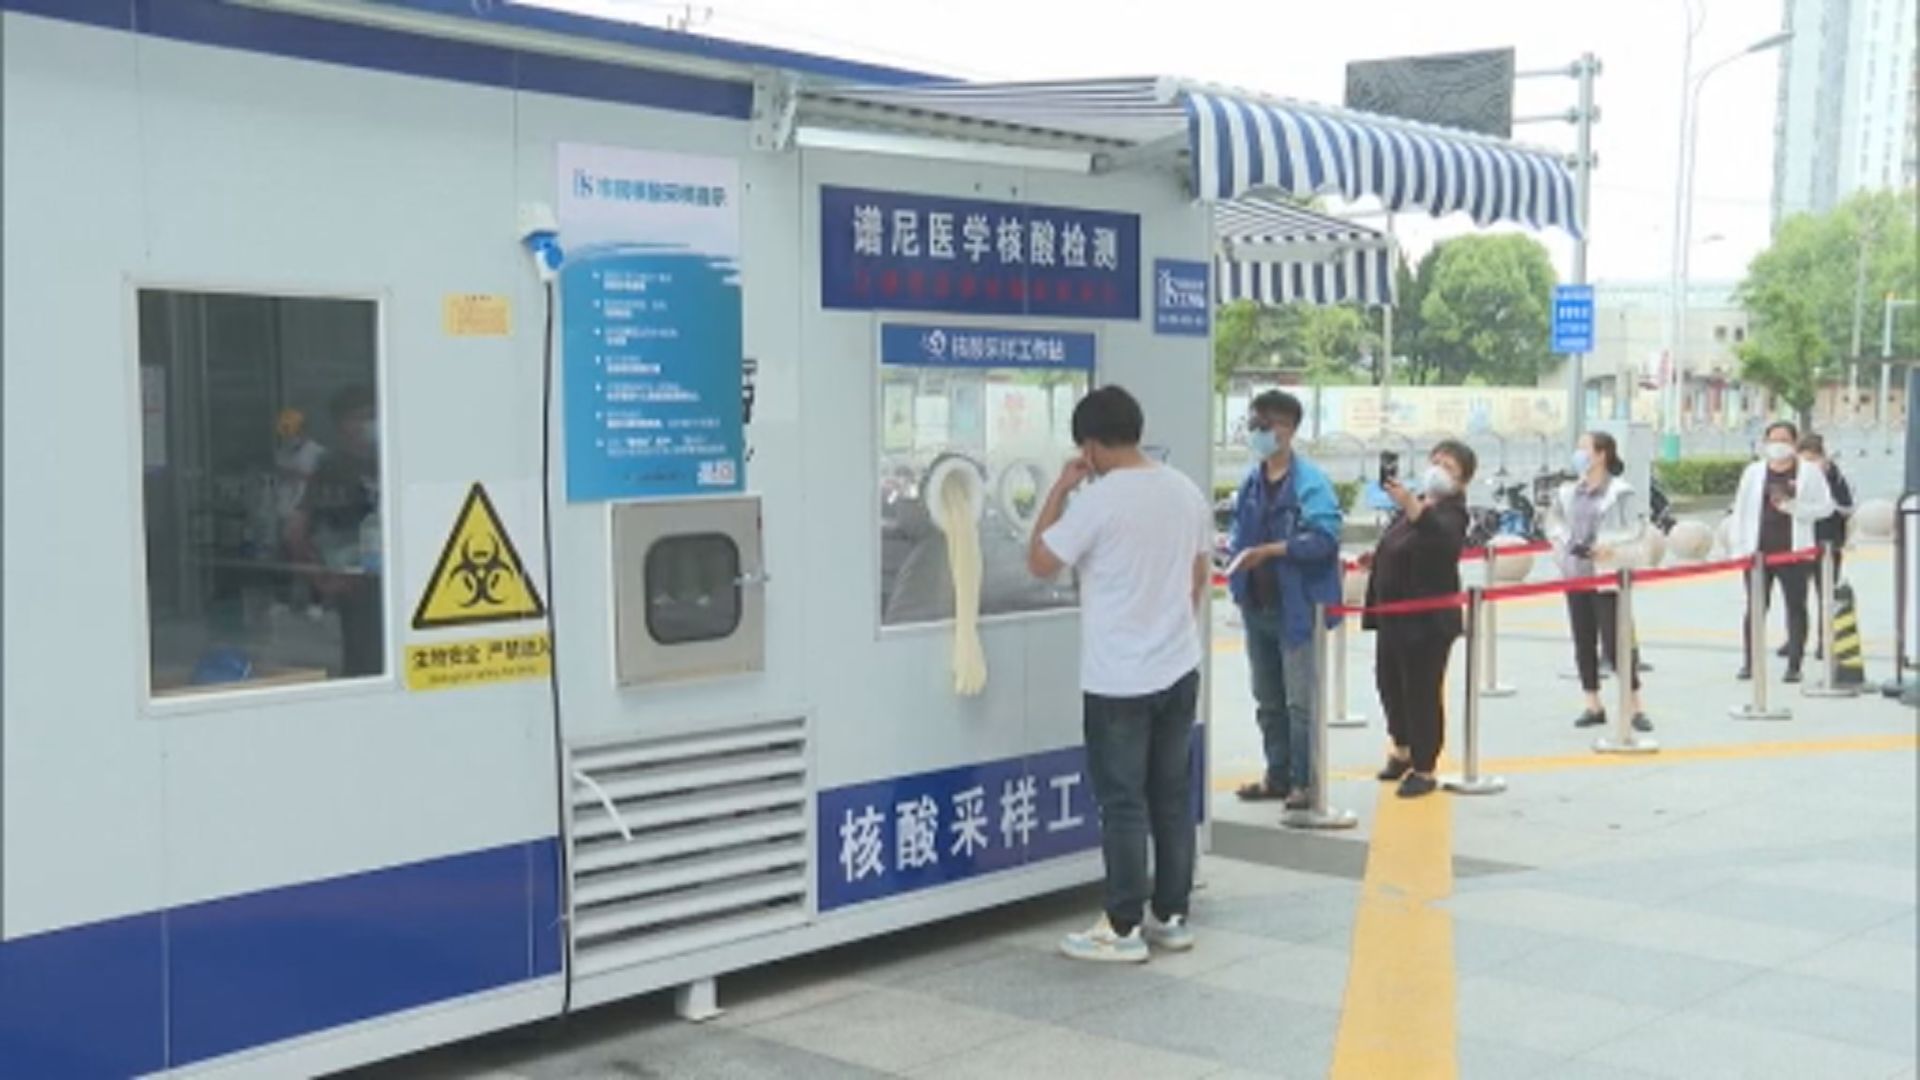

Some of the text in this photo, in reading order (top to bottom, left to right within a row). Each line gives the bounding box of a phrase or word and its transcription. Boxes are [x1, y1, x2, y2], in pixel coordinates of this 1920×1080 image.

[853, 205, 1118, 271] 谱尼医学核酸检测
[952, 335, 1066, 362] 核酸采样工作站
[413, 646, 480, 667] 生物安全
[840, 771, 1100, 883] 核酸采样工
